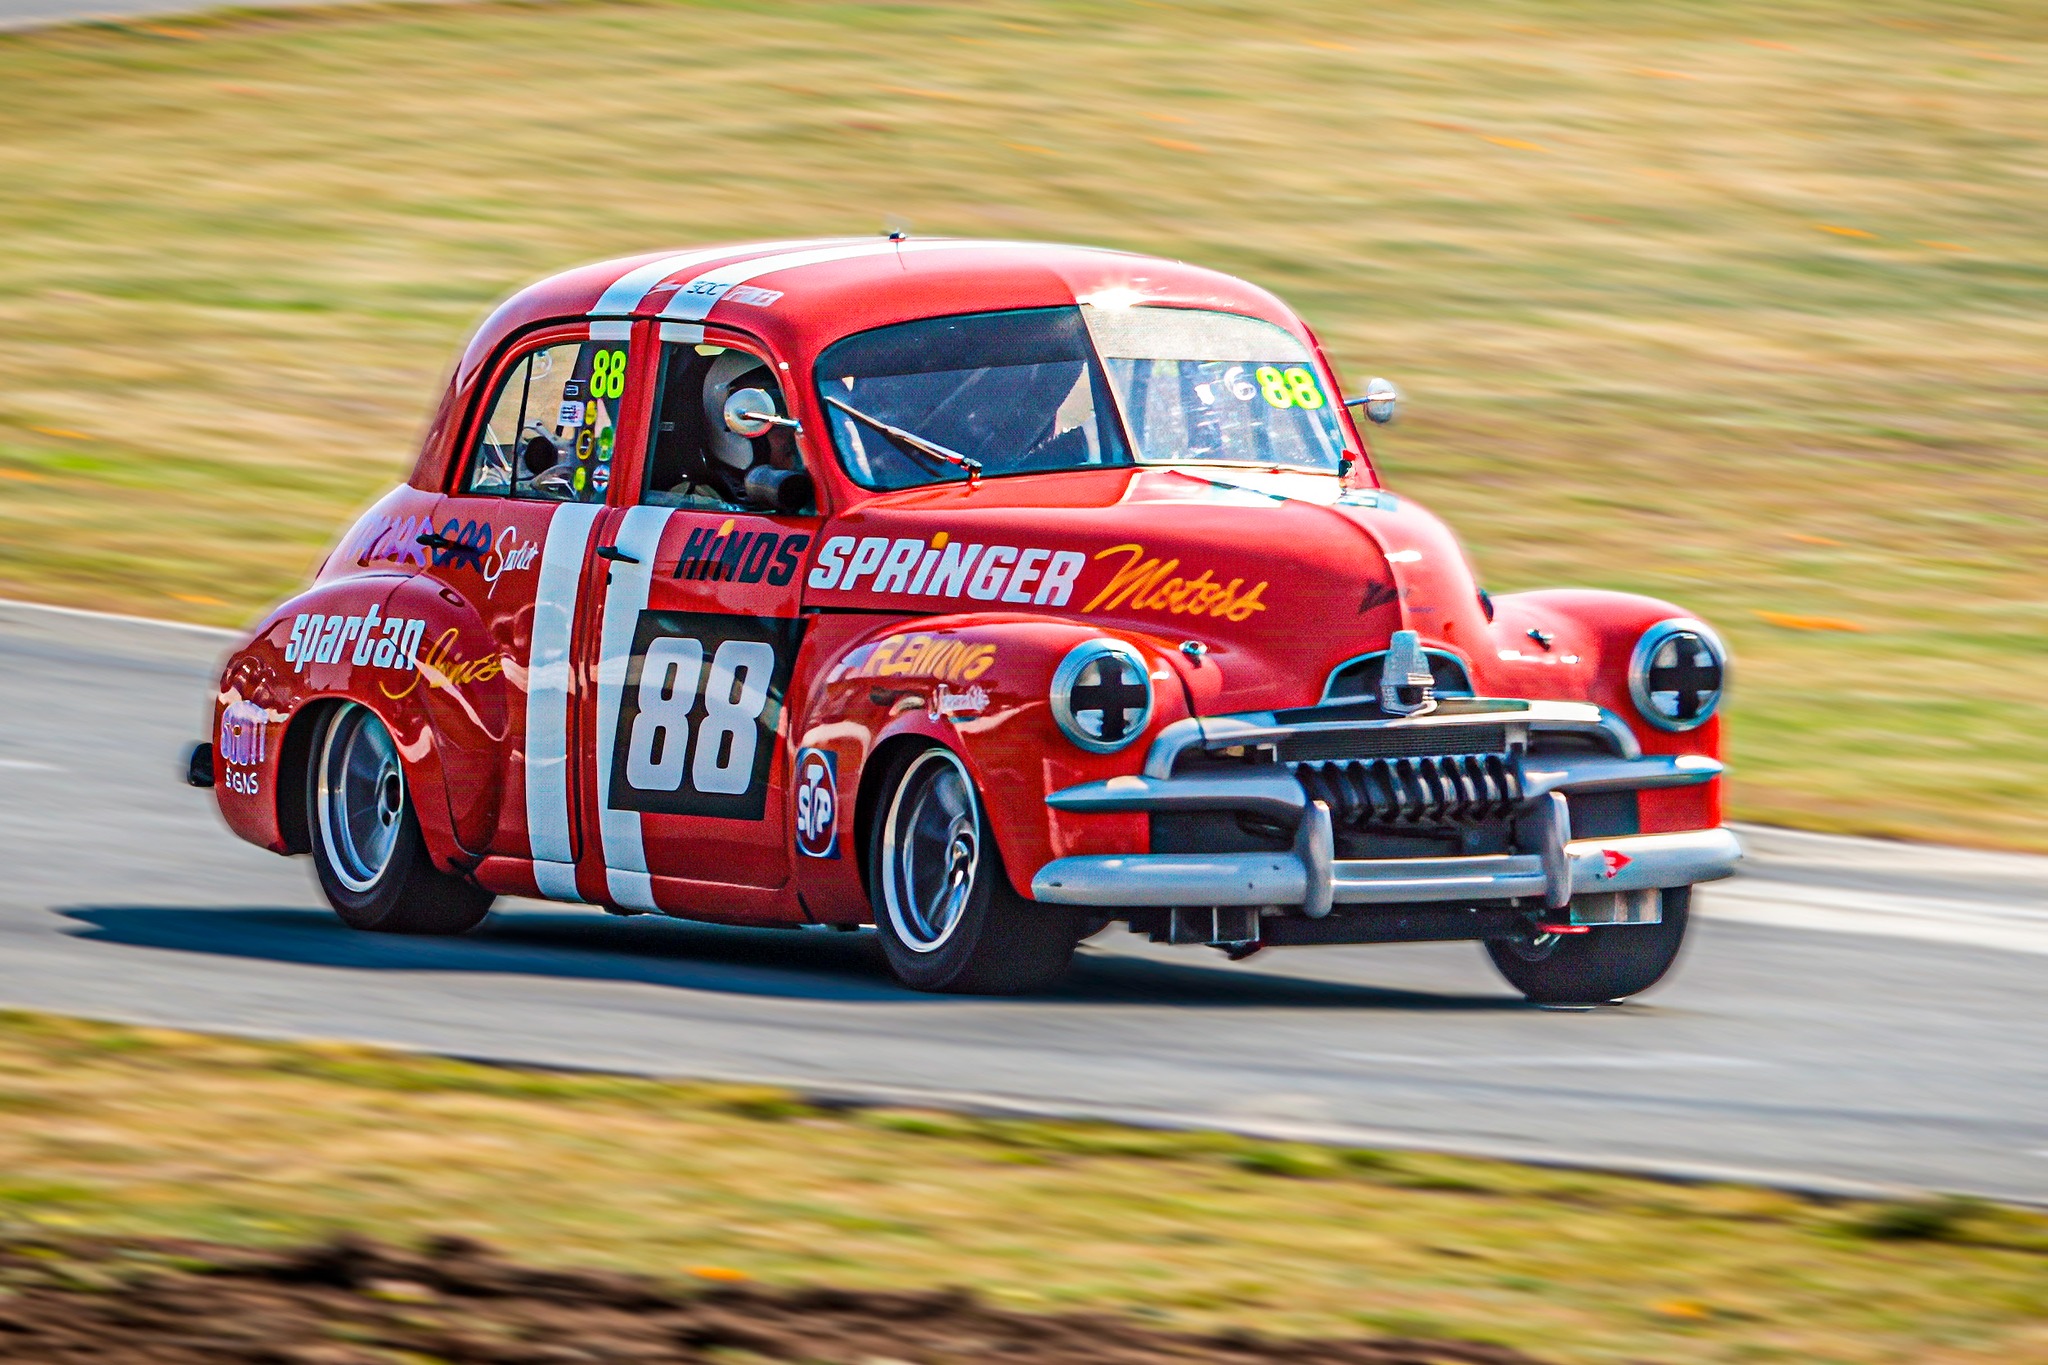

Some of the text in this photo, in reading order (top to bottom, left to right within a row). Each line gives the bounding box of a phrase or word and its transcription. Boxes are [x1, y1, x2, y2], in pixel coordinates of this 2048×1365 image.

[590, 349, 627, 399] 88
[1256, 366, 1324, 410] 88
[1081, 544, 1269, 621] Motors
[285, 604, 426, 673] spartan
[626, 636, 775, 795] 88
[797, 765, 832, 841] STP
